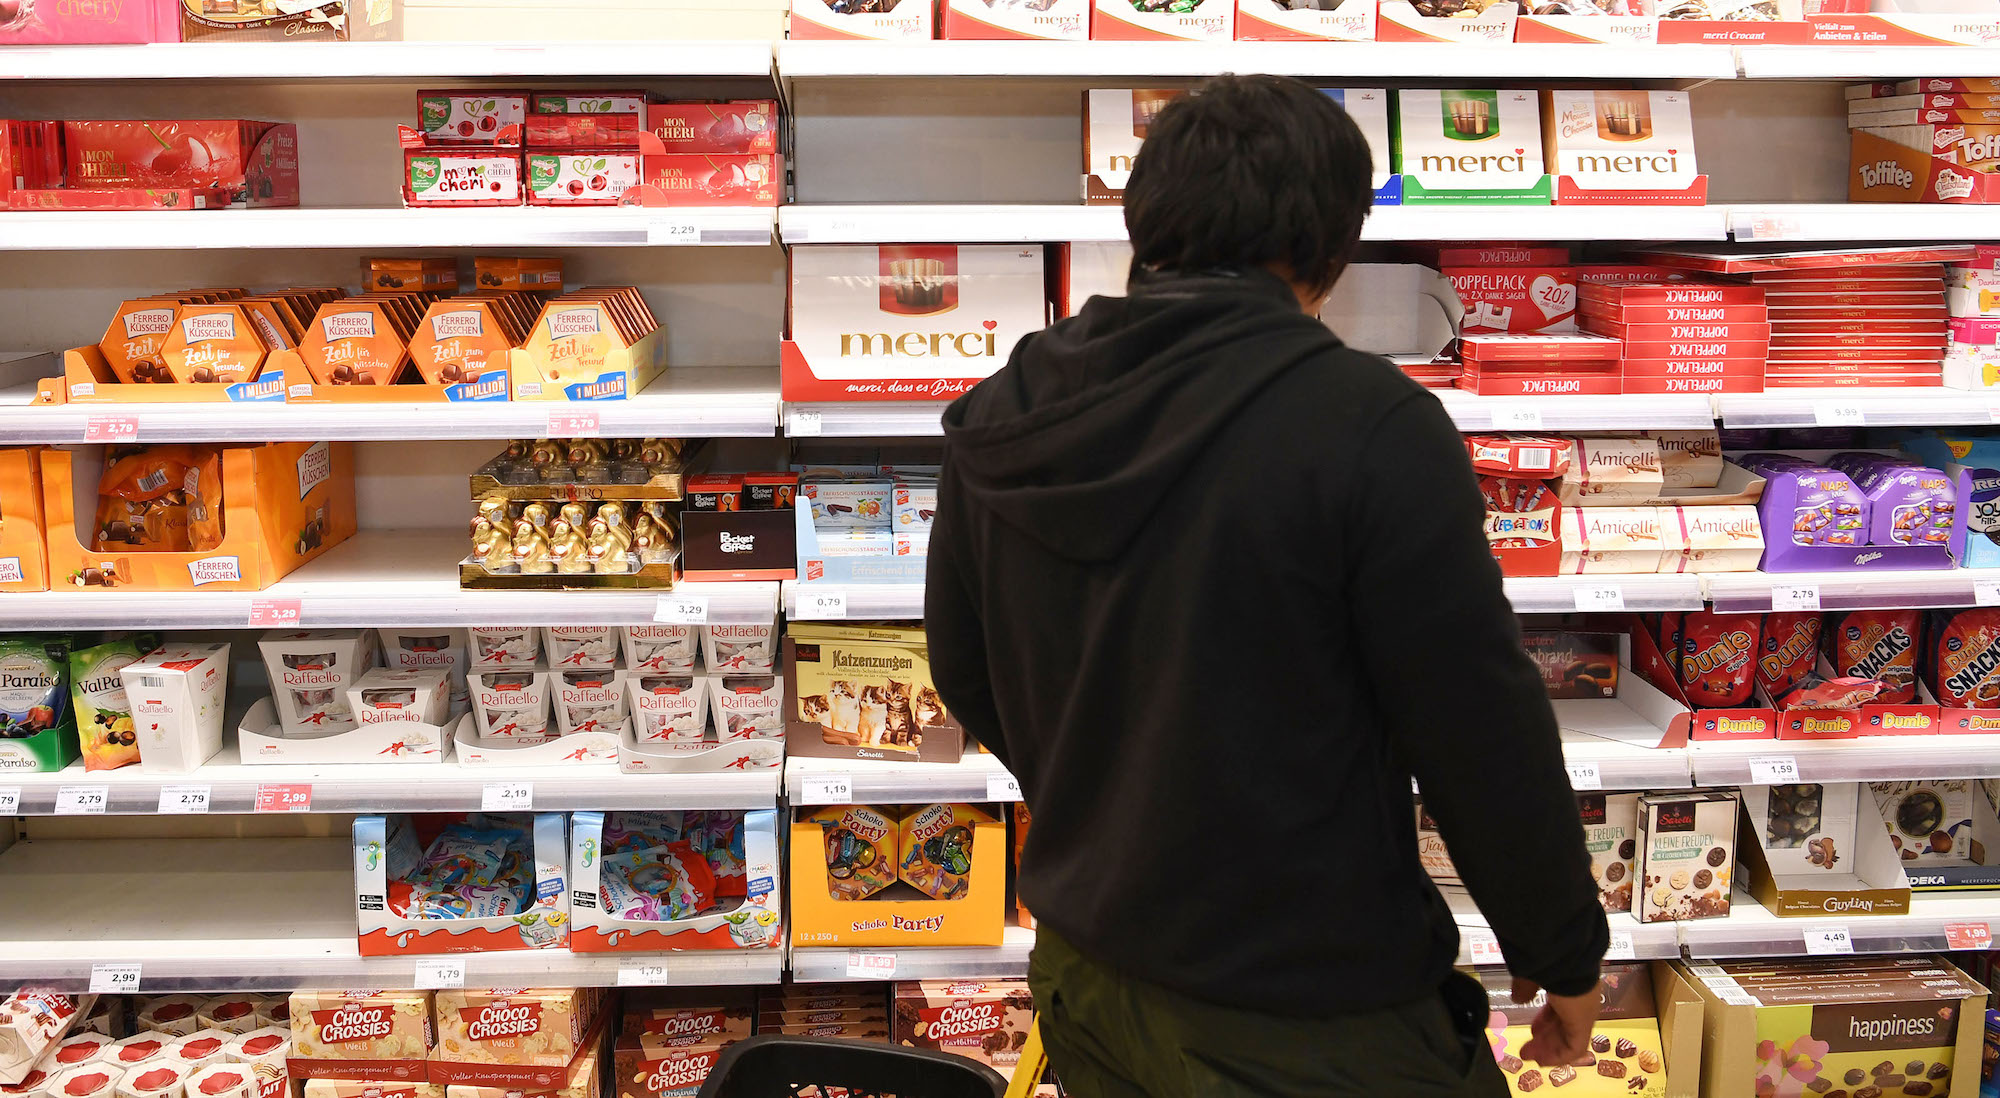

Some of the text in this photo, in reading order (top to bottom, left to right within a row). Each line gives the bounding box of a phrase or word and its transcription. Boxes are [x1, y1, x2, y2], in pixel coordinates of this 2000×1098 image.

[874, 15, 923, 27] merci
[1814, 23, 1837, 31] Vielfalt
[284, 22, 326, 37] Classic
[1729, 31, 1765, 40] Crocant
[1814, 32, 1887, 41] Anbieten & Teilen
[664, 118, 686, 127] MON
[1421, 148, 1525, 173] merci
[1577, 149, 1678, 173] merci
[661, 168, 683, 178] MON
[1859, 160, 1913, 189] Toffifee
[440, 176, 484, 192] chéri
[671, 226, 695, 234] 2,29
[1480, 251, 1531, 263] DOPPELPACK
[1471, 291, 1526, 300] 2X DANKE SAGEN
[1539, 286, 1570, 305] -20%
[1666, 290, 1723, 302] DOPPELPACK
[133, 314, 169, 323] FERRERO
[441, 315, 476, 325] FERRERO
[557, 313, 593, 324] FERRERO
[1667, 308, 1725, 321] DOPPELPACK
[130, 322, 171, 332] KÜSSCHEN
[192, 318, 228, 328] FERRERO
[331, 317, 368, 327] FERRERO
[554, 322, 596, 333] KÜSSCHEN
[189, 327, 231, 338] KÜSSCHEN
[328, 325, 371, 338] KÜSSCHEN
[438, 324, 479, 335] KÜSSCHEN
[1671, 326, 1728, 338] DOPPELPACK
[840, 320, 998, 357] merci
[123, 338, 156, 360] Zeit
[182, 343, 231, 366] Zeit für
[322, 342, 354, 364] Zeit
[431, 340, 463, 363] Zeit
[547, 339, 579, 362] Zeit
[1670, 344, 1727, 355] DOPPELPACK
[212, 361, 246, 372] Freunde
[353, 359, 389, 370] Küsschen
[1666, 361, 1723, 373] DOPPELPACK
[238, 379, 286, 398] 1 MILLION
[457, 379, 506, 398] 1 MILLION
[576, 379, 624, 398] 1 MILLION
[845, 379, 965, 395] merci, dass es Dich
[1522, 380, 1580, 392] DOPPELPACK
[1666, 379, 1723, 391] DOPPELPACK
[799, 413, 819, 421] 5,79
[1513, 412, 1536, 421] 4,99
[108, 424, 133, 434] 2,79
[570, 419, 594, 428] 2,79
[1656, 435, 1715, 452] Amicelli
[1950, 445, 1967, 453] NEW
[1589, 450, 1655, 468] Amicelli
[1798, 475, 1817, 487] Milka
[1820, 480, 1850, 491] NAPS
[1920, 478, 1947, 490] NAPS
[752, 486, 773, 494] Pocket
[752, 491, 772, 500] Coffee
[1589, 518, 1654, 534] Amicelli
[1690, 518, 1754, 534] Amicelli
[719, 531, 755, 543] Pocket
[720, 541, 754, 552] Coffee
[197, 561, 233, 571] FERRERO
[195, 570, 238, 581] KÜSSCHEN
[1594, 590, 1617, 599] 2,79
[1792, 590, 1814, 599] 2,79
[817, 598, 841, 607] 0,79
[271, 609, 296, 619] 3,29
[678, 604, 702, 614] 3,29
[710, 626, 769, 638] Raffaello
[868, 631, 902, 640] Katzenzungen
[1682, 631, 1752, 683] Dumle
[1846, 626, 1912, 679] SNACKS
[400, 653, 455, 666] Raffaello
[833, 650, 913, 671] Katzenzungen
[1726, 655, 1750, 673] original
[1887, 666, 1912, 674] original
[283, 671, 341, 685] Raffaello
[481, 692, 539, 706] Raffaello
[562, 689, 620, 703] Raffaello
[721, 695, 779, 709] Raffaello
[639, 695, 697, 710] Raffaello
[138, 704, 174, 714] Raffaello
[362, 710, 420, 723] Raffaello
[1881, 712, 1931, 729] Dumle
[1717, 714, 1767, 733] Dumle
[1803, 716, 1852, 733] Dumle
[857, 749, 884, 758] Sarotti
[1573, 769, 1594, 778] 1,19
[1771, 765, 1793, 774] 1,59
[504, 789, 527, 799] 2,19
[824, 785, 847, 794] 1,19
[78, 795, 102, 805] 2,79
[181, 794, 205, 804] 2,79
[282, 793, 307, 803] 2,99
[853, 808, 884, 827] Schoko
[915, 804, 943, 827] Schoko
[1659, 813, 1693, 826] Sarotti
[841, 811, 889, 842] Party
[912, 805, 957, 842] Party
[1593, 826, 1625, 840] FREUDEN
[1654, 834, 1715, 850] KLEINE FREUDEN
[852, 913, 945, 933] Schoko Party
[800, 933, 809, 941] 12
[817, 932, 832, 941] 250
[1824, 933, 1845, 942] 4,49
[1964, 929, 1987, 938] 1,99
[436, 969, 460, 979] 1,79
[638, 966, 663, 976] 1,79
[112, 973, 136, 983] 2,99
[332, 1009, 382, 1030] CHOCO
[479, 1006, 529, 1027] CHOCO
[939, 1004, 992, 1027] CHOCO
[321, 1019, 390, 1043] CROSSIES
[469, 1017, 538, 1041] CROSSIES
[664, 1015, 714, 1035] CHOCO
[929, 1014, 1000, 1041] CROSSIES
[1849, 1013, 1935, 1041] happiness
[344, 1040, 369, 1051] Weiß
[491, 1037, 516, 1048] Weiß
[943, 1037, 981, 1048] Zartbitter
[308, 1065, 392, 1076] Voller Knuspergenuss!
[658, 1055, 709, 1076] CHOCO
[450, 1071, 535, 1082] Voller Knuspergenuss!
[663, 1087, 699, 1098] Original
